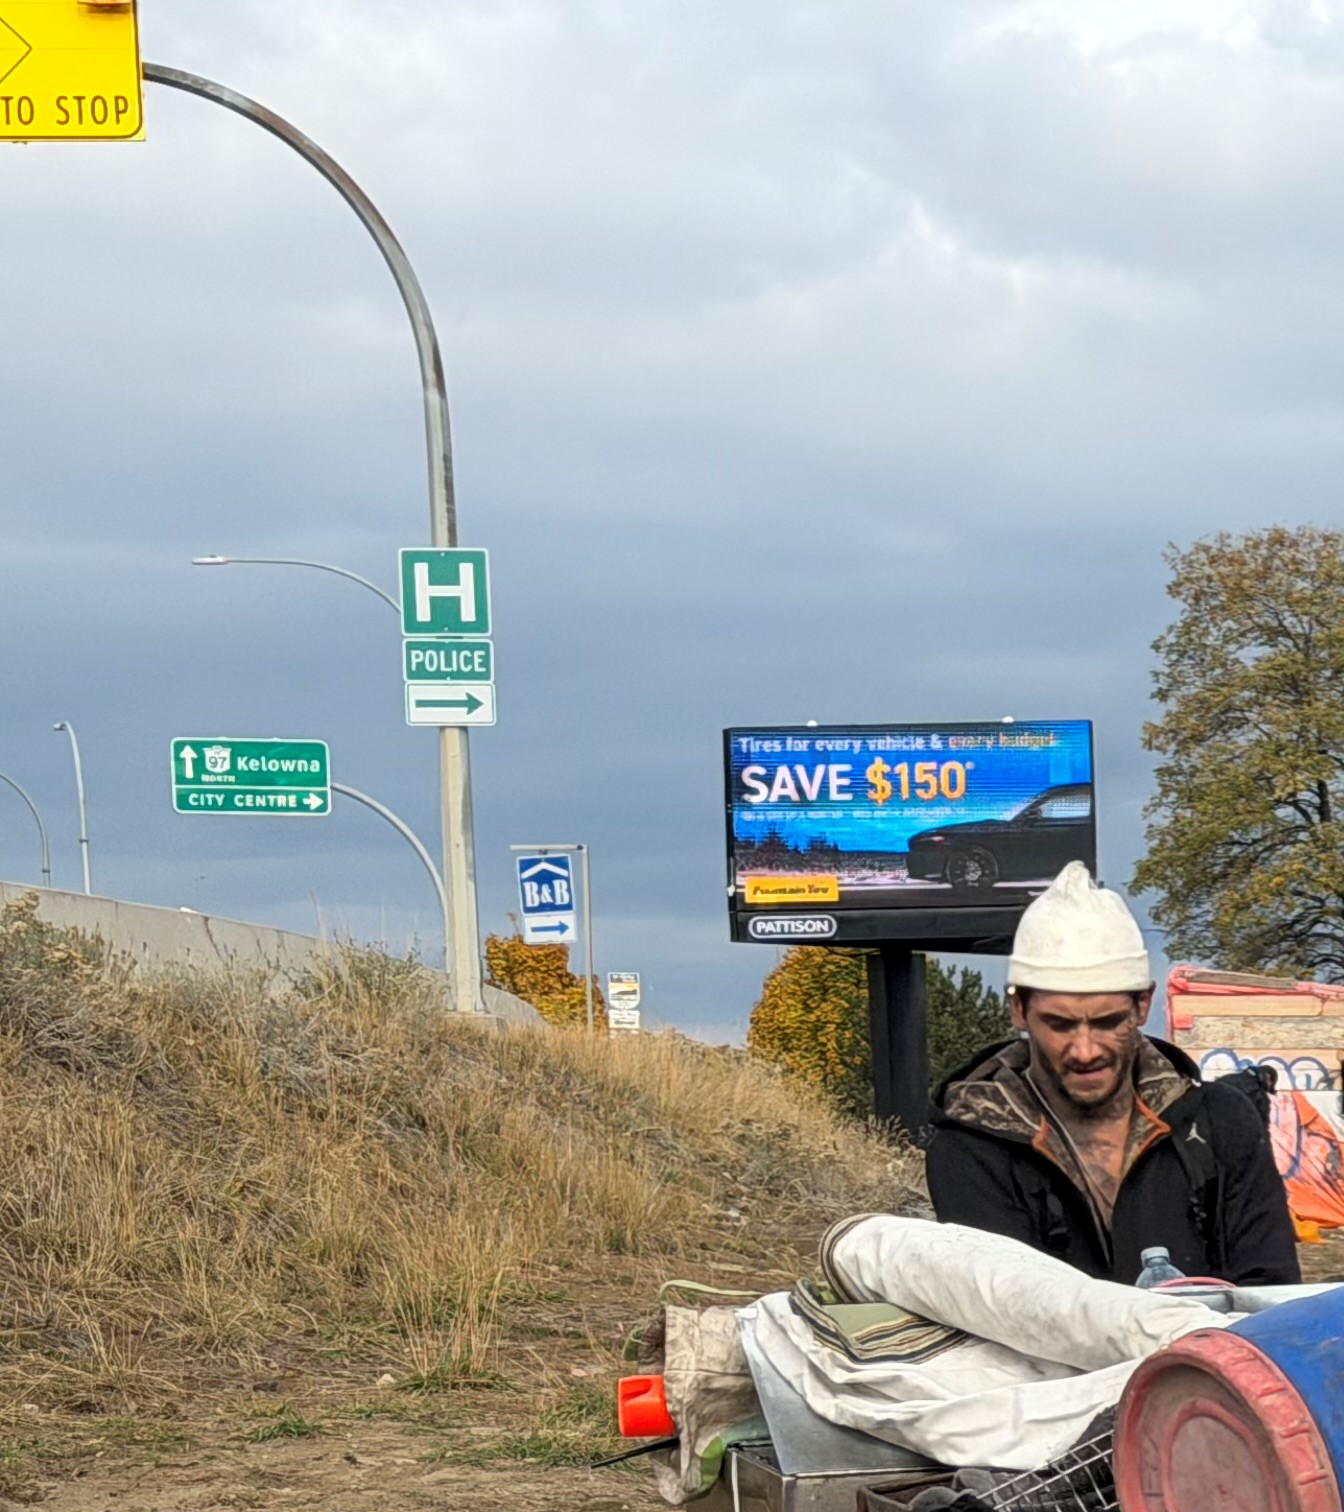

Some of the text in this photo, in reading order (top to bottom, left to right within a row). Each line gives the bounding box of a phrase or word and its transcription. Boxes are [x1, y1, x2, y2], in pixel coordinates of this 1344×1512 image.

[0, 95, 129, 126] TO STOP
[413, 562, 476, 622] H
[410, 649, 487, 672] POLICE
[738, 737, 782, 754] Tires
[786, 736, 810, 752] for
[815, 738, 862, 755] every
[865, 735, 925, 751] vehicle
[930, 734, 943, 751] &
[208, 755, 321, 773] 97 Kelowna
[201, 774, 236, 783] NORTH
[741, 764, 854, 803] SAVE
[188, 793, 298, 808] CITY CENTRE
[523, 879, 570, 908] B&B
[756, 920, 830, 934] PATTISON
